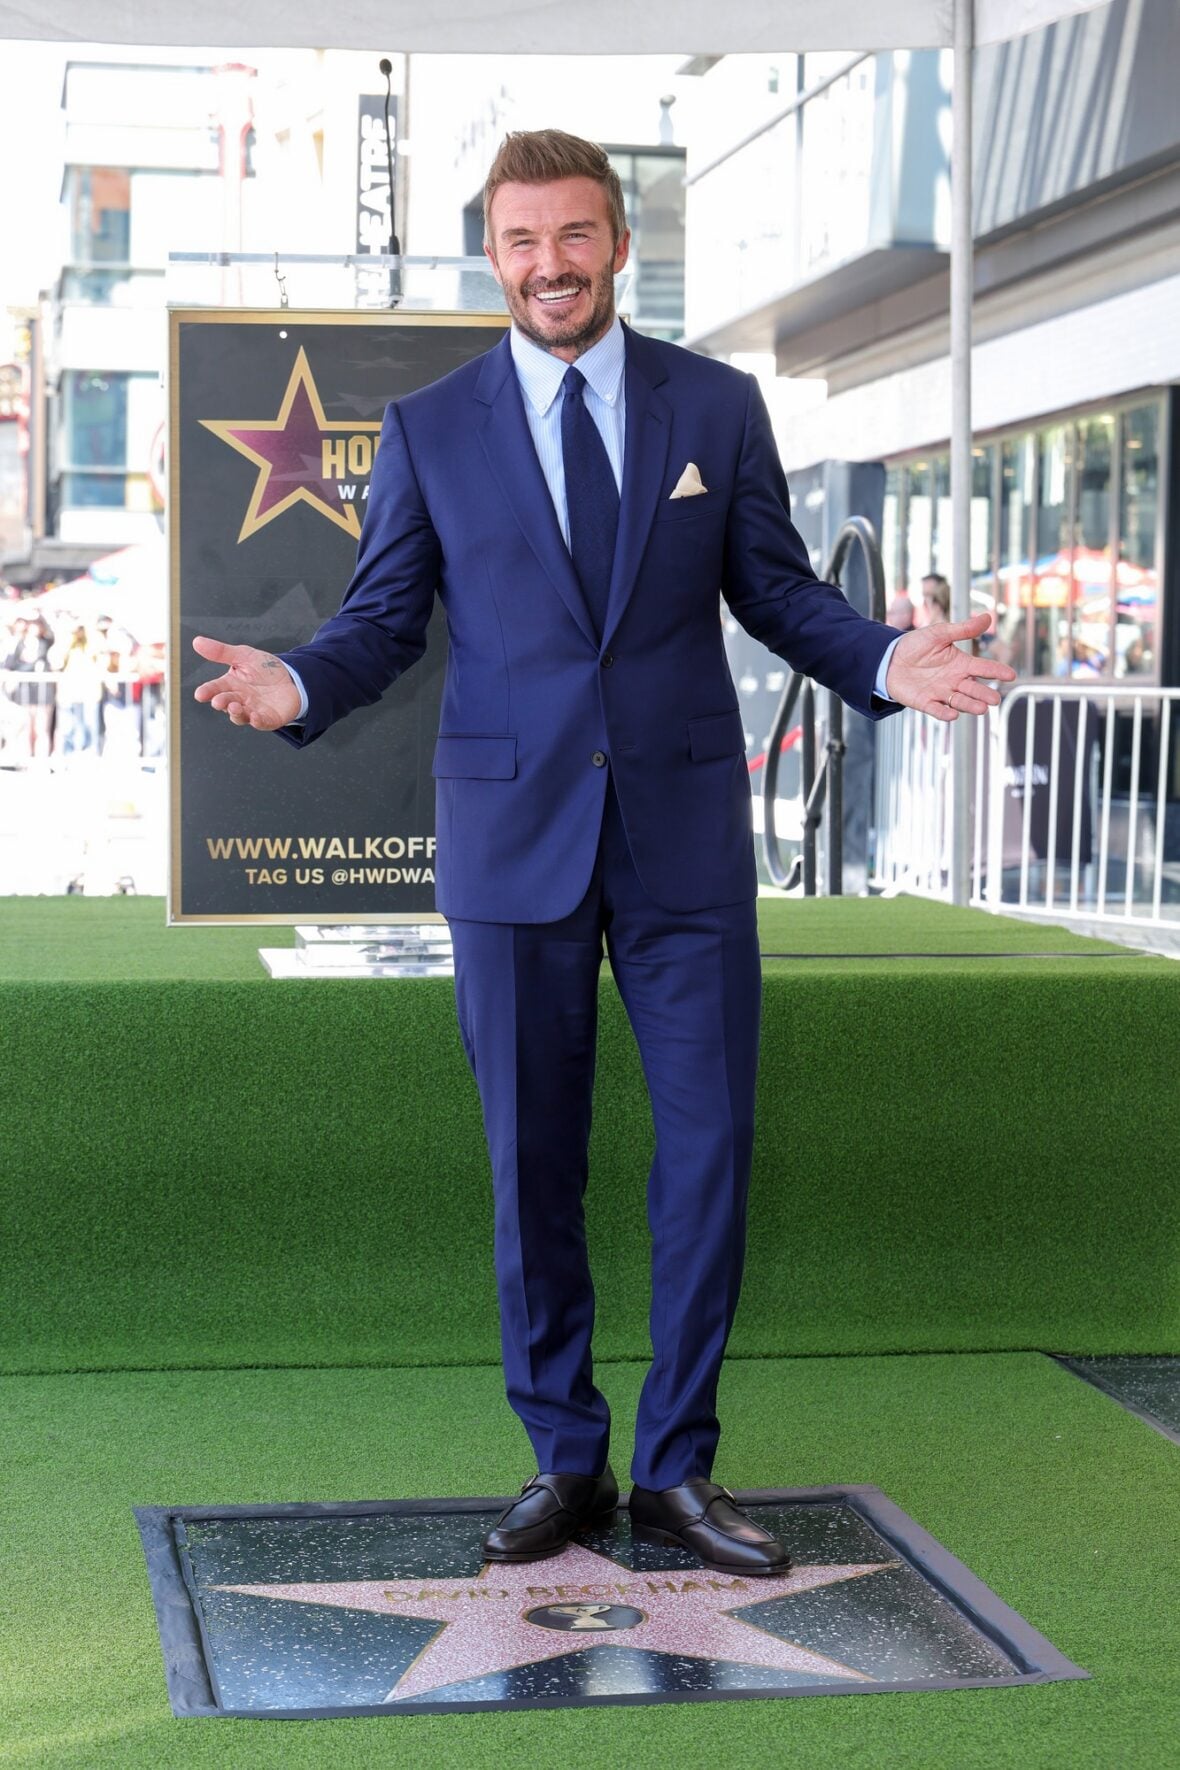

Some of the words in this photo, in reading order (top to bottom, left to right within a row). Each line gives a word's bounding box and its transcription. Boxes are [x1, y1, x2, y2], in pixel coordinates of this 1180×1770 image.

[245, 868, 288, 885] TAG
[294, 868, 325, 885] US
[383, 1586, 509, 1604] DAVID
[526, 1578, 750, 1599] BECKHAM
